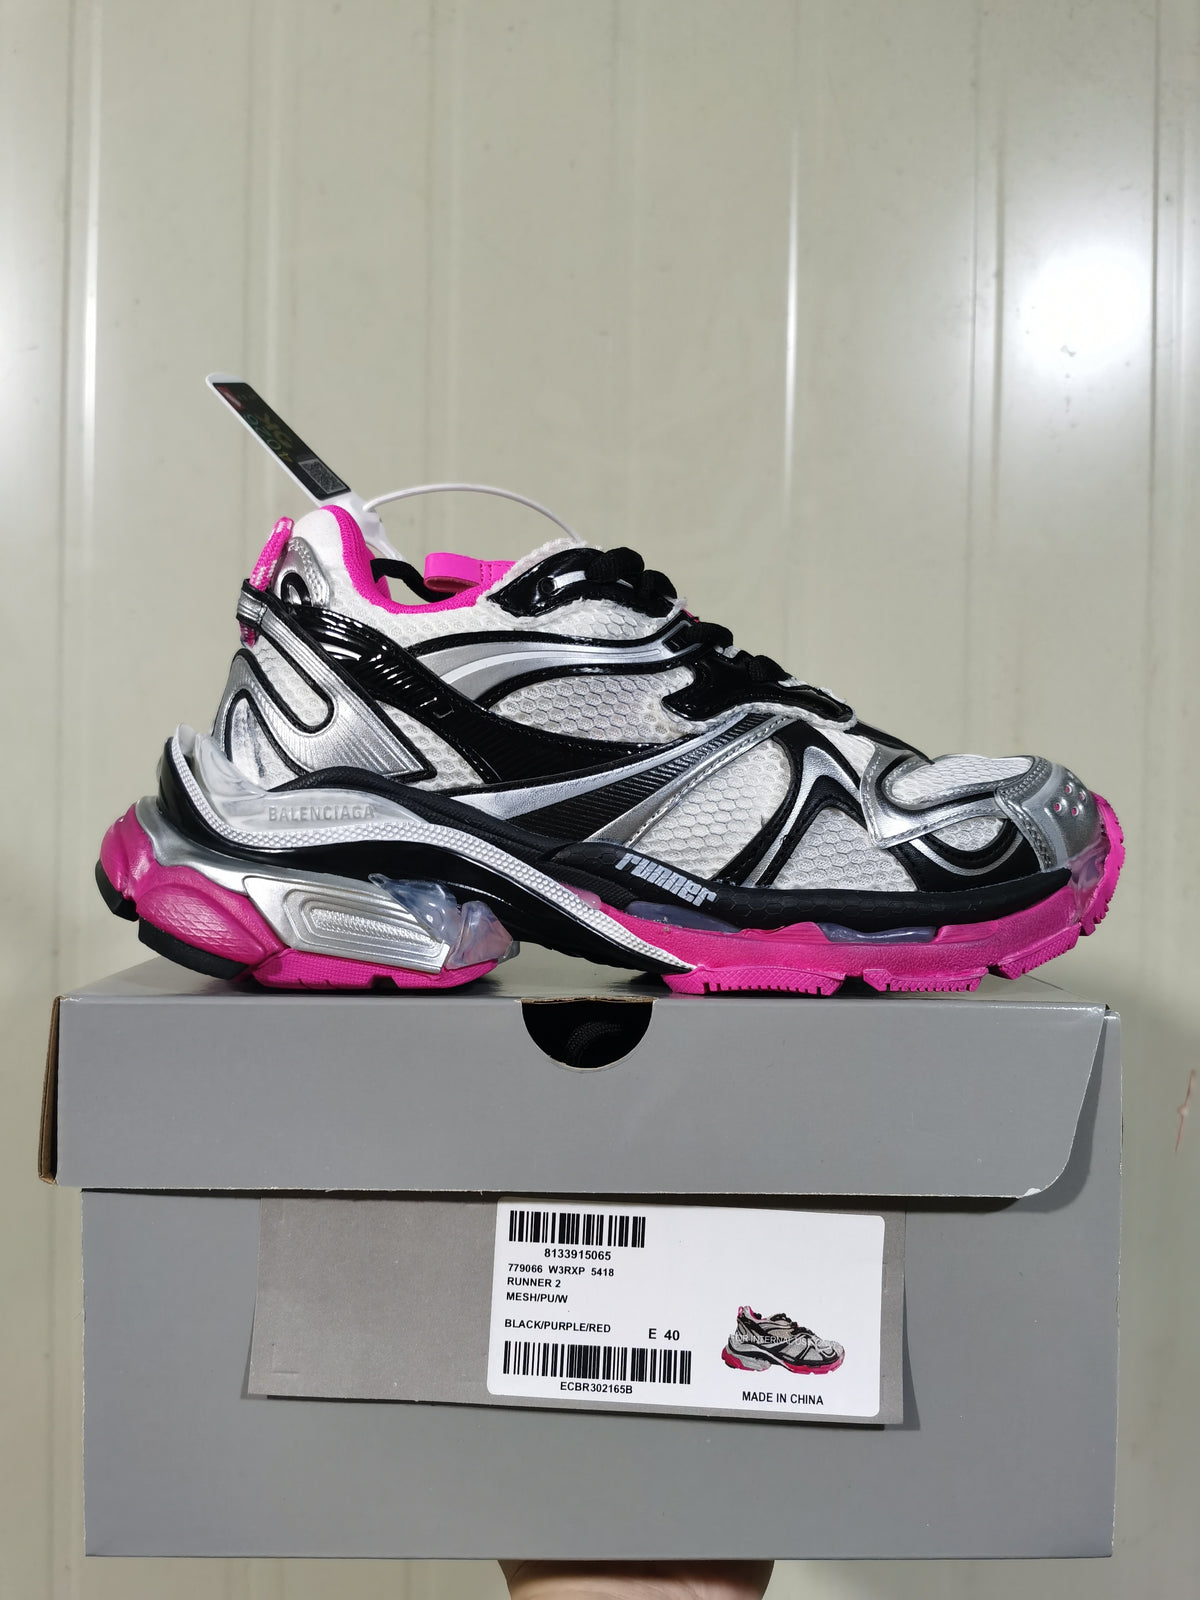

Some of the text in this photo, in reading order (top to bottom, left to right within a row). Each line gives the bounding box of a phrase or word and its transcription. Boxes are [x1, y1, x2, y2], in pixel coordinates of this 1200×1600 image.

[268, 805, 376, 822] BALENCIAGA
[615, 853, 717, 907] runner
[544, 1248, 612, 1261] 8133915065
[508, 1263, 615, 1277] 779066 W3RXP 5418
[507, 1277, 562, 1288] RUNNER 2
[506, 1292, 568, 1304] MESH/PU/W
[504, 1318, 612, 1333] BLACK/PURPLE/RED
[648, 1328, 680, 1341] E 40
[560, 1381, 633, 1395] ECBR302165B
[743, 1391, 824, 1406] MADE IN CHINA
